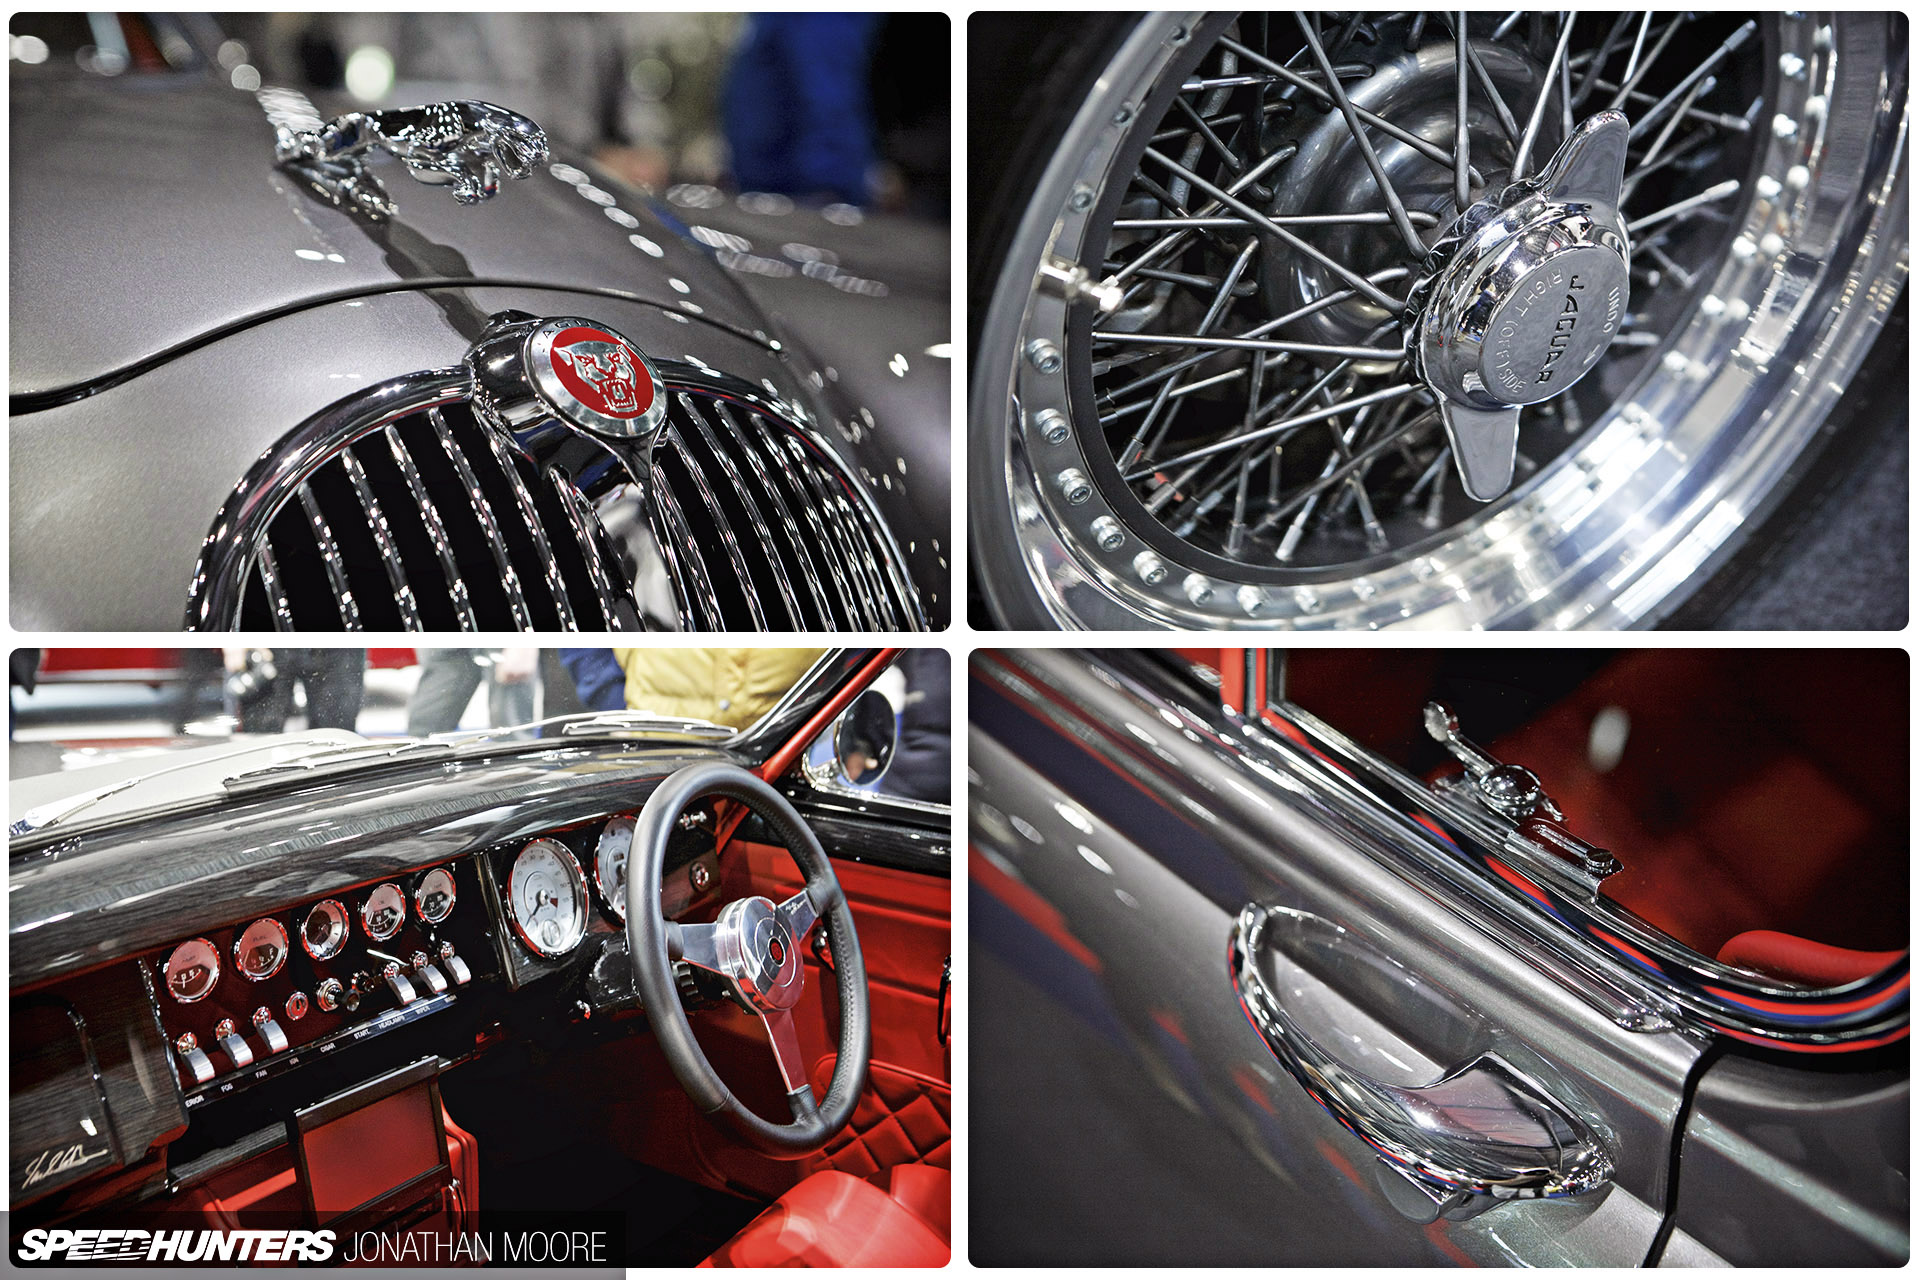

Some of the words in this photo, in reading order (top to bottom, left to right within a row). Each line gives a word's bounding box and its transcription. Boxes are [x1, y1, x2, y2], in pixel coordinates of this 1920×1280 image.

[1515, 268, 1563, 317] RIGHT
[1603, 286, 1620, 334] UNDO
[1535, 275, 1585, 384] JAGUAR
[1498, 368, 1527, 393] SIDE
[220, 1083, 233, 1093] FOG
[255, 1069, 268, 1079] FAN
[320, 1042, 336, 1053] CIGAR
